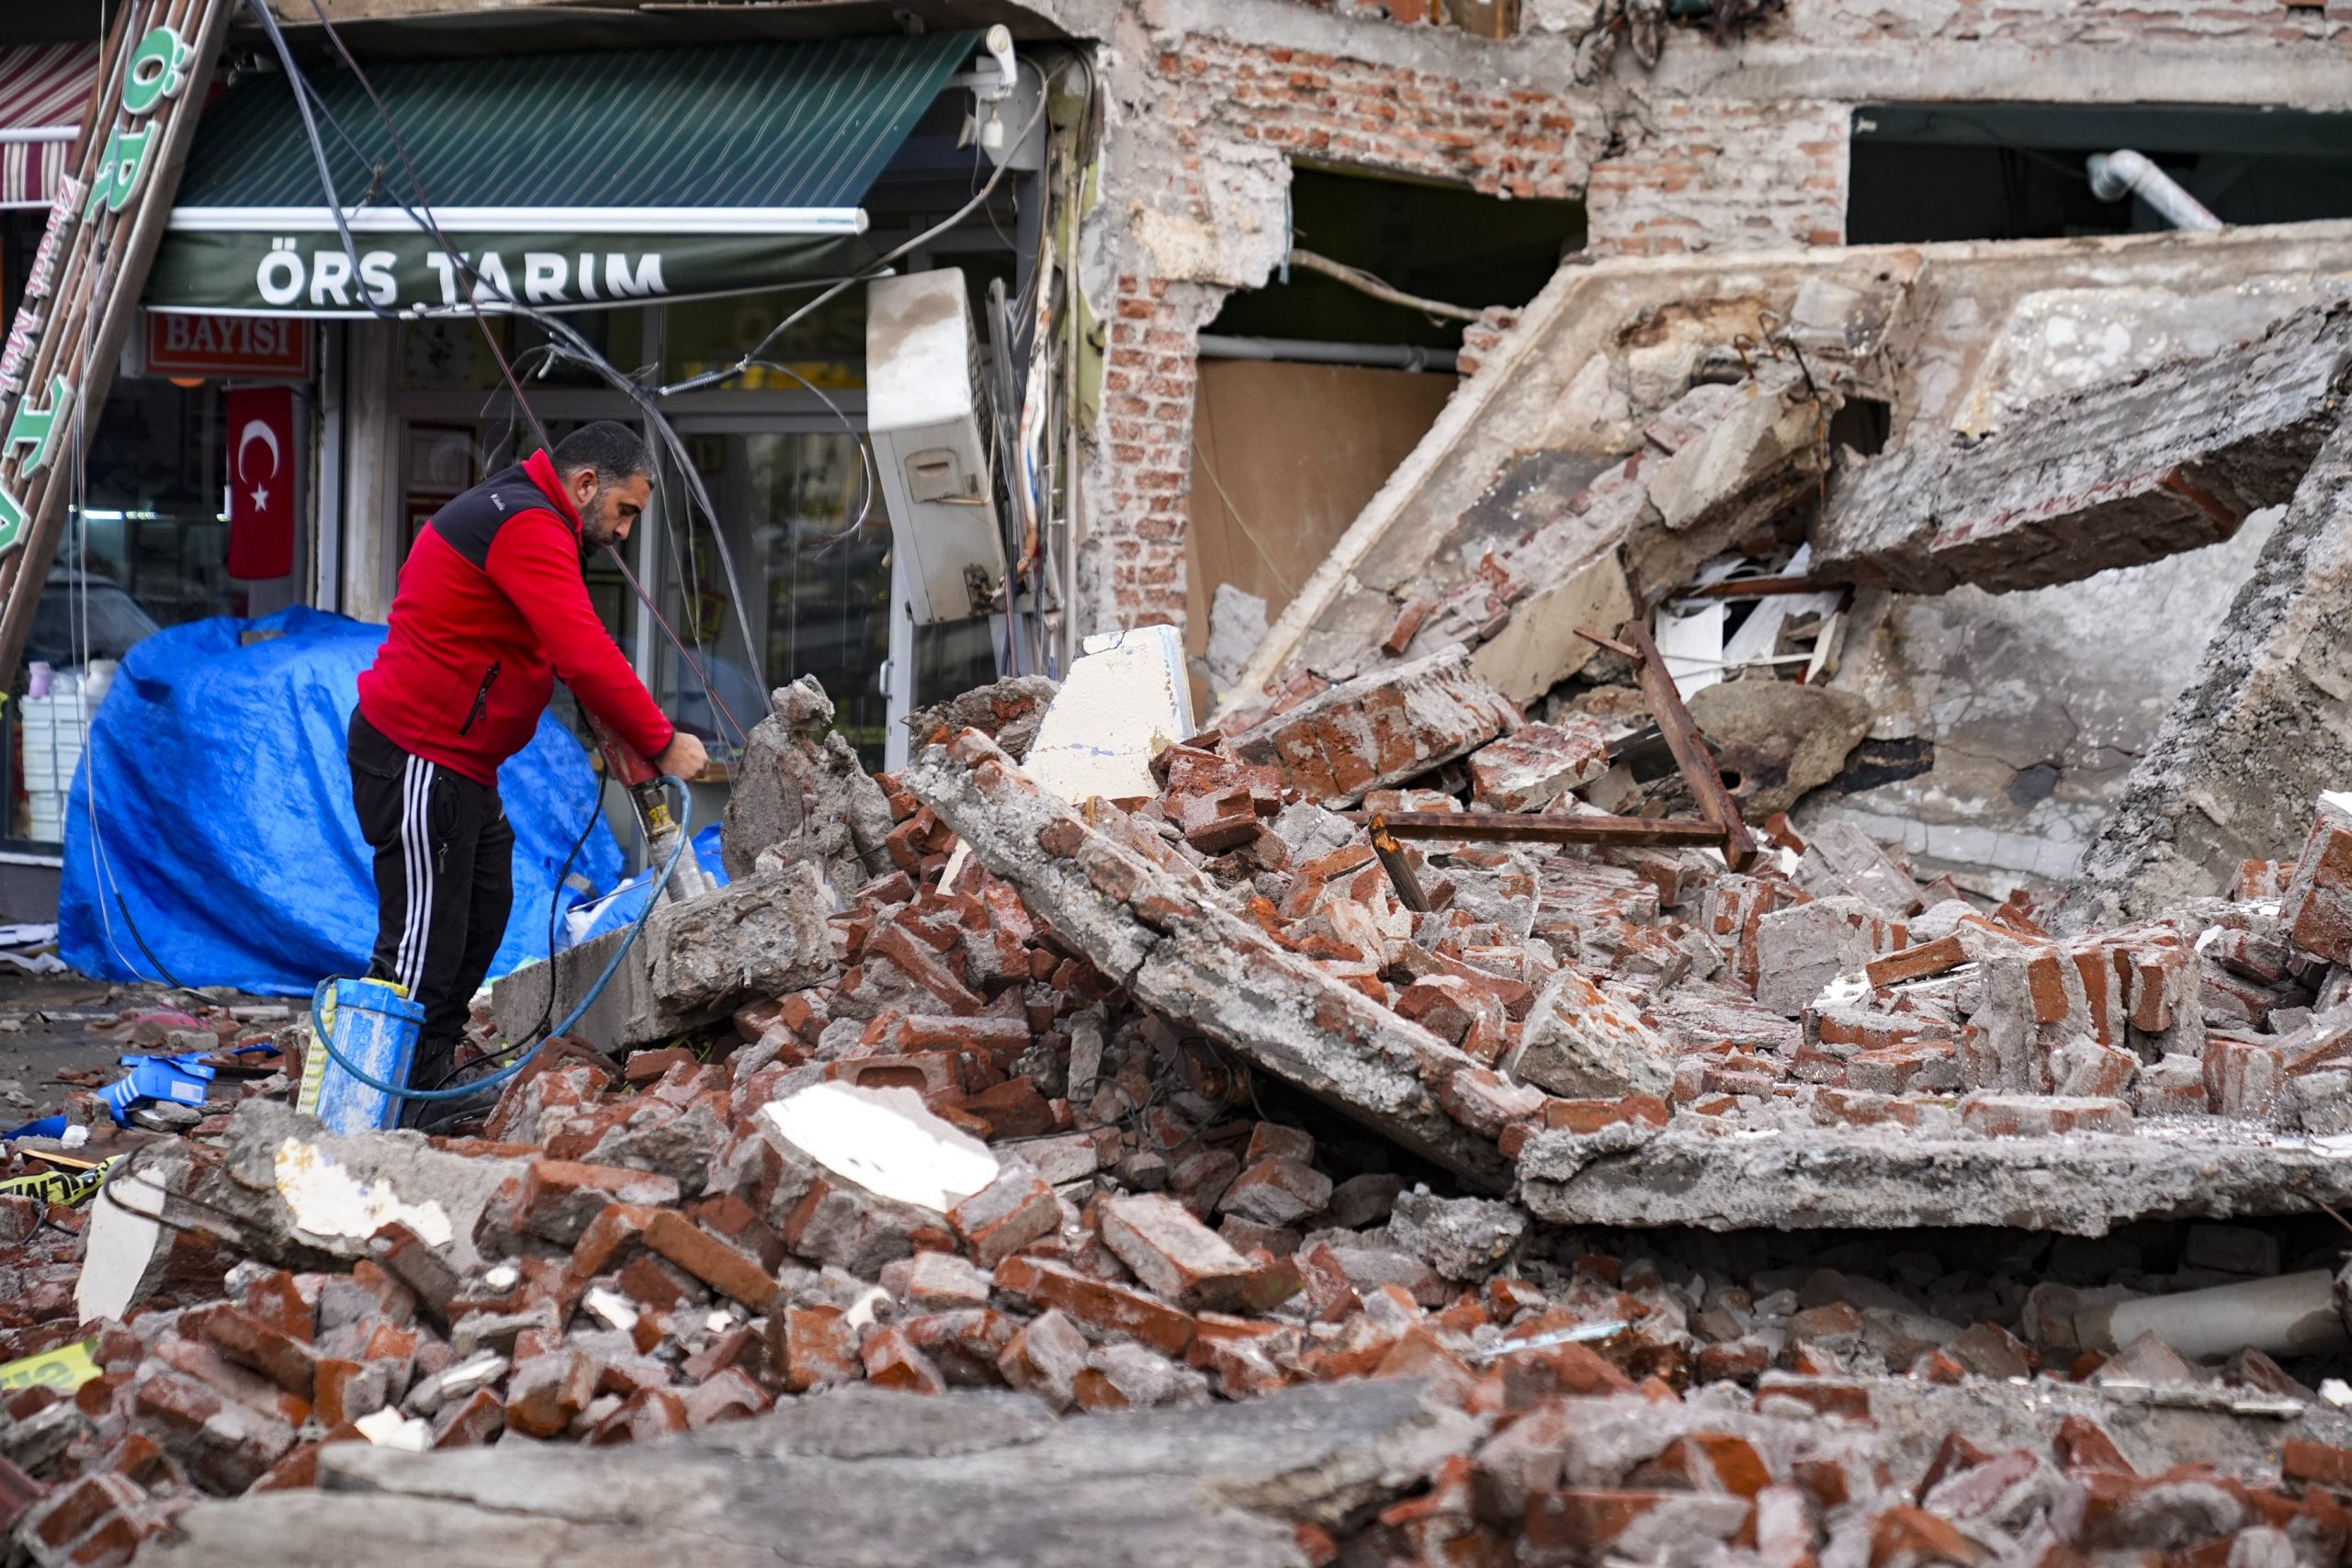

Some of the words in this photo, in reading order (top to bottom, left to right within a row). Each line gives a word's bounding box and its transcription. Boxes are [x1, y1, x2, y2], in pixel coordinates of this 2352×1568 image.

[25, 173, 83, 299] Ziraat
[256, 237, 398, 307] ÖRS
[426, 251, 670, 304] TARIM
